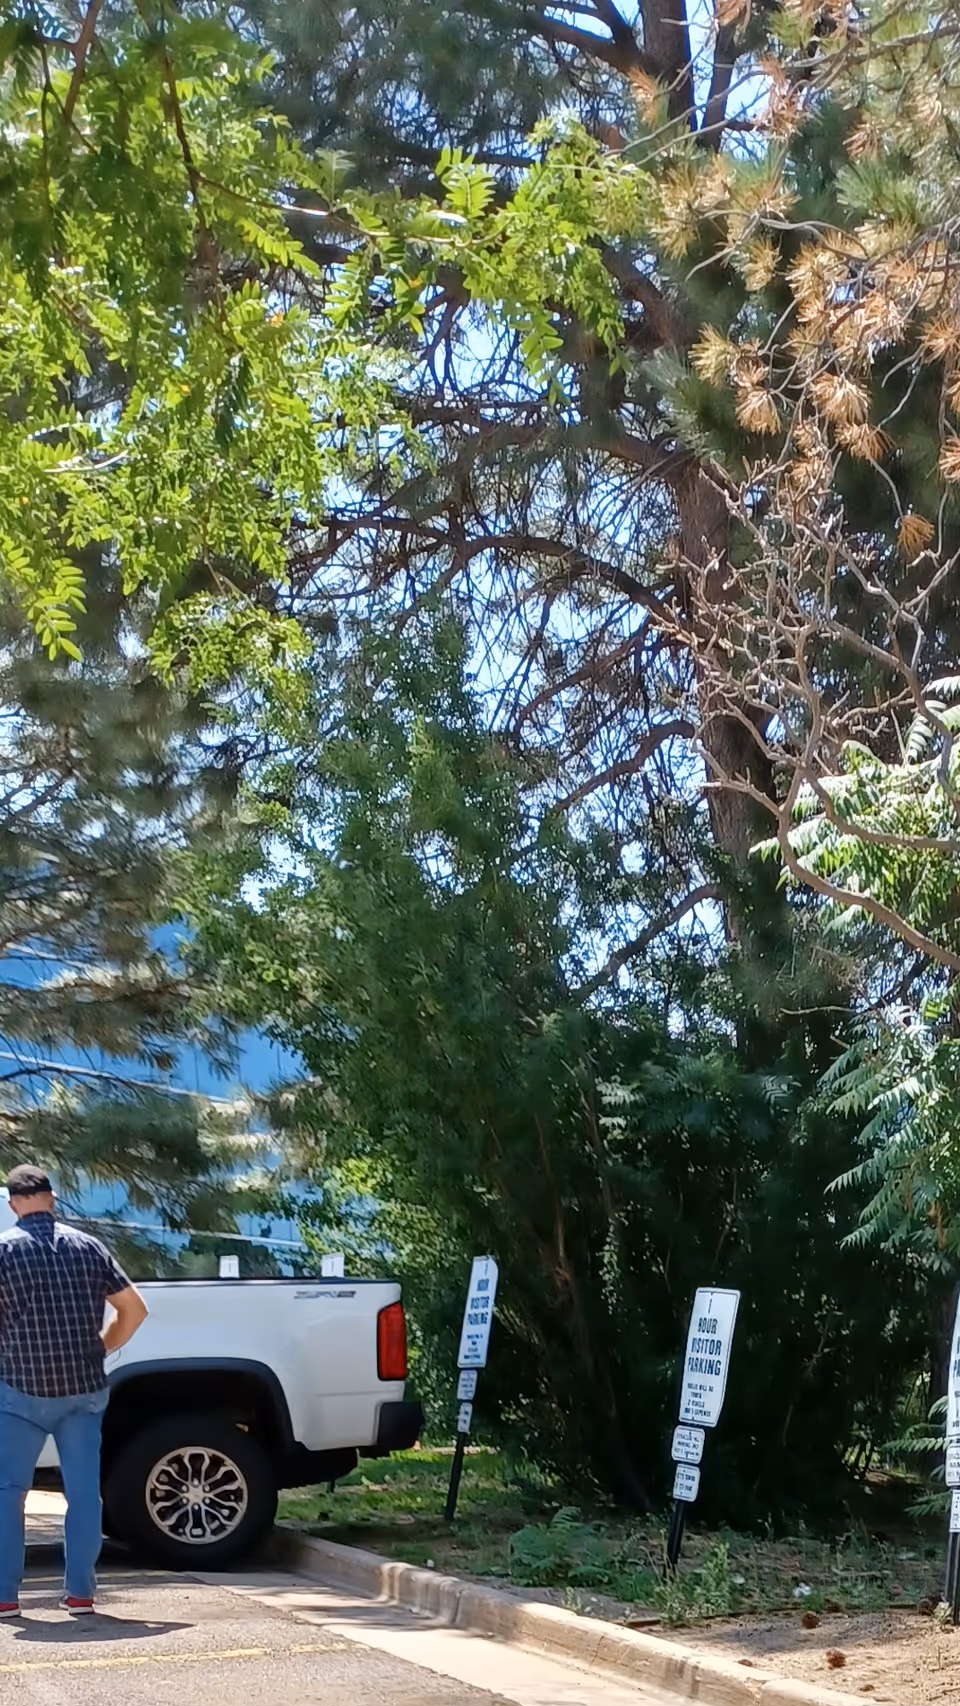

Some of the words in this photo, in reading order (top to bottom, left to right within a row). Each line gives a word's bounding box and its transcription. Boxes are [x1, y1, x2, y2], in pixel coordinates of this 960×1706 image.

[697, 1317, 718, 1335] HOUR
[691, 1337, 722, 1356] VISITOR
[688, 1356, 722, 1376] PARKING
